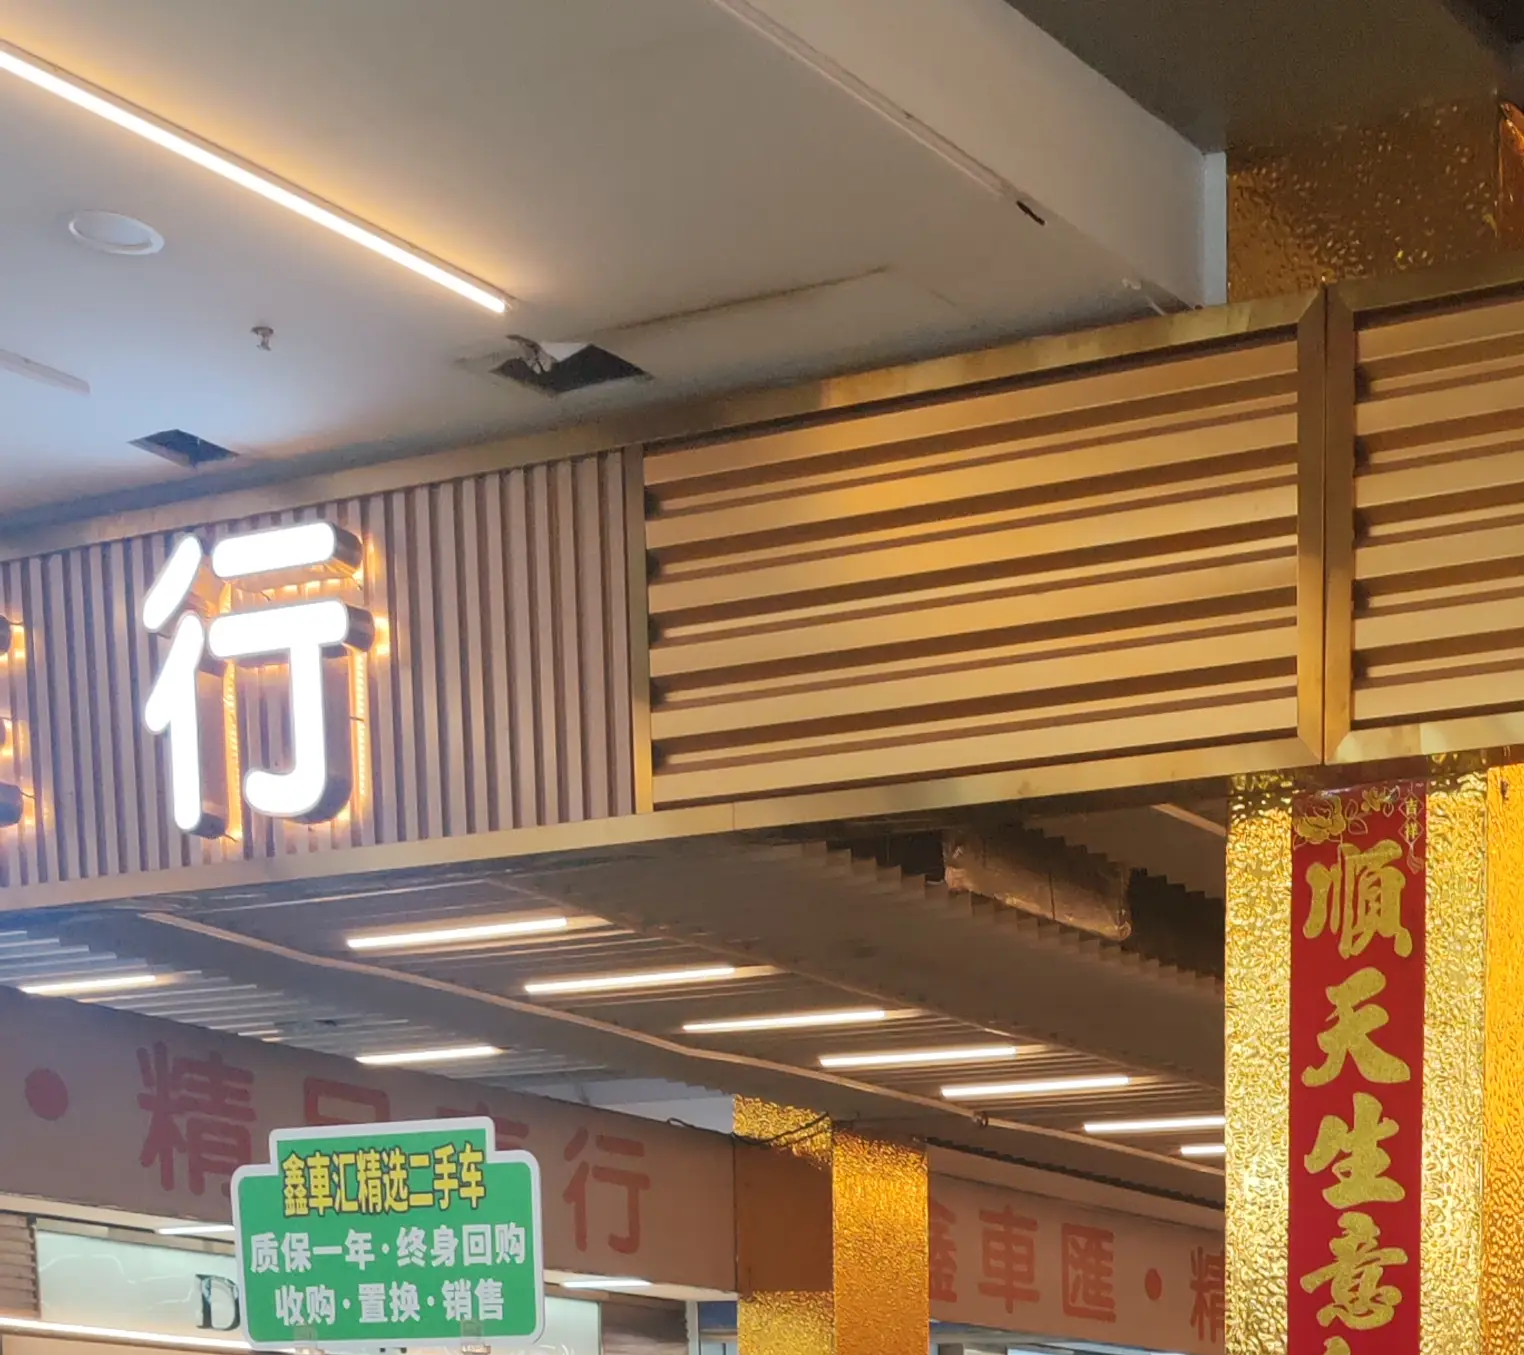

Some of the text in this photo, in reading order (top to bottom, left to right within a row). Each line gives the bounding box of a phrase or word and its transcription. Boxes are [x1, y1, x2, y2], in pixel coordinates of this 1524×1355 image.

[143, 520, 350, 832] 行
[283, 1141, 486, 1217] 鑫車汇精选二手车
[250, 1222, 526, 1273] 质保一年·终身回购
[274, 1279, 504, 1327] 收购·置换·销售
